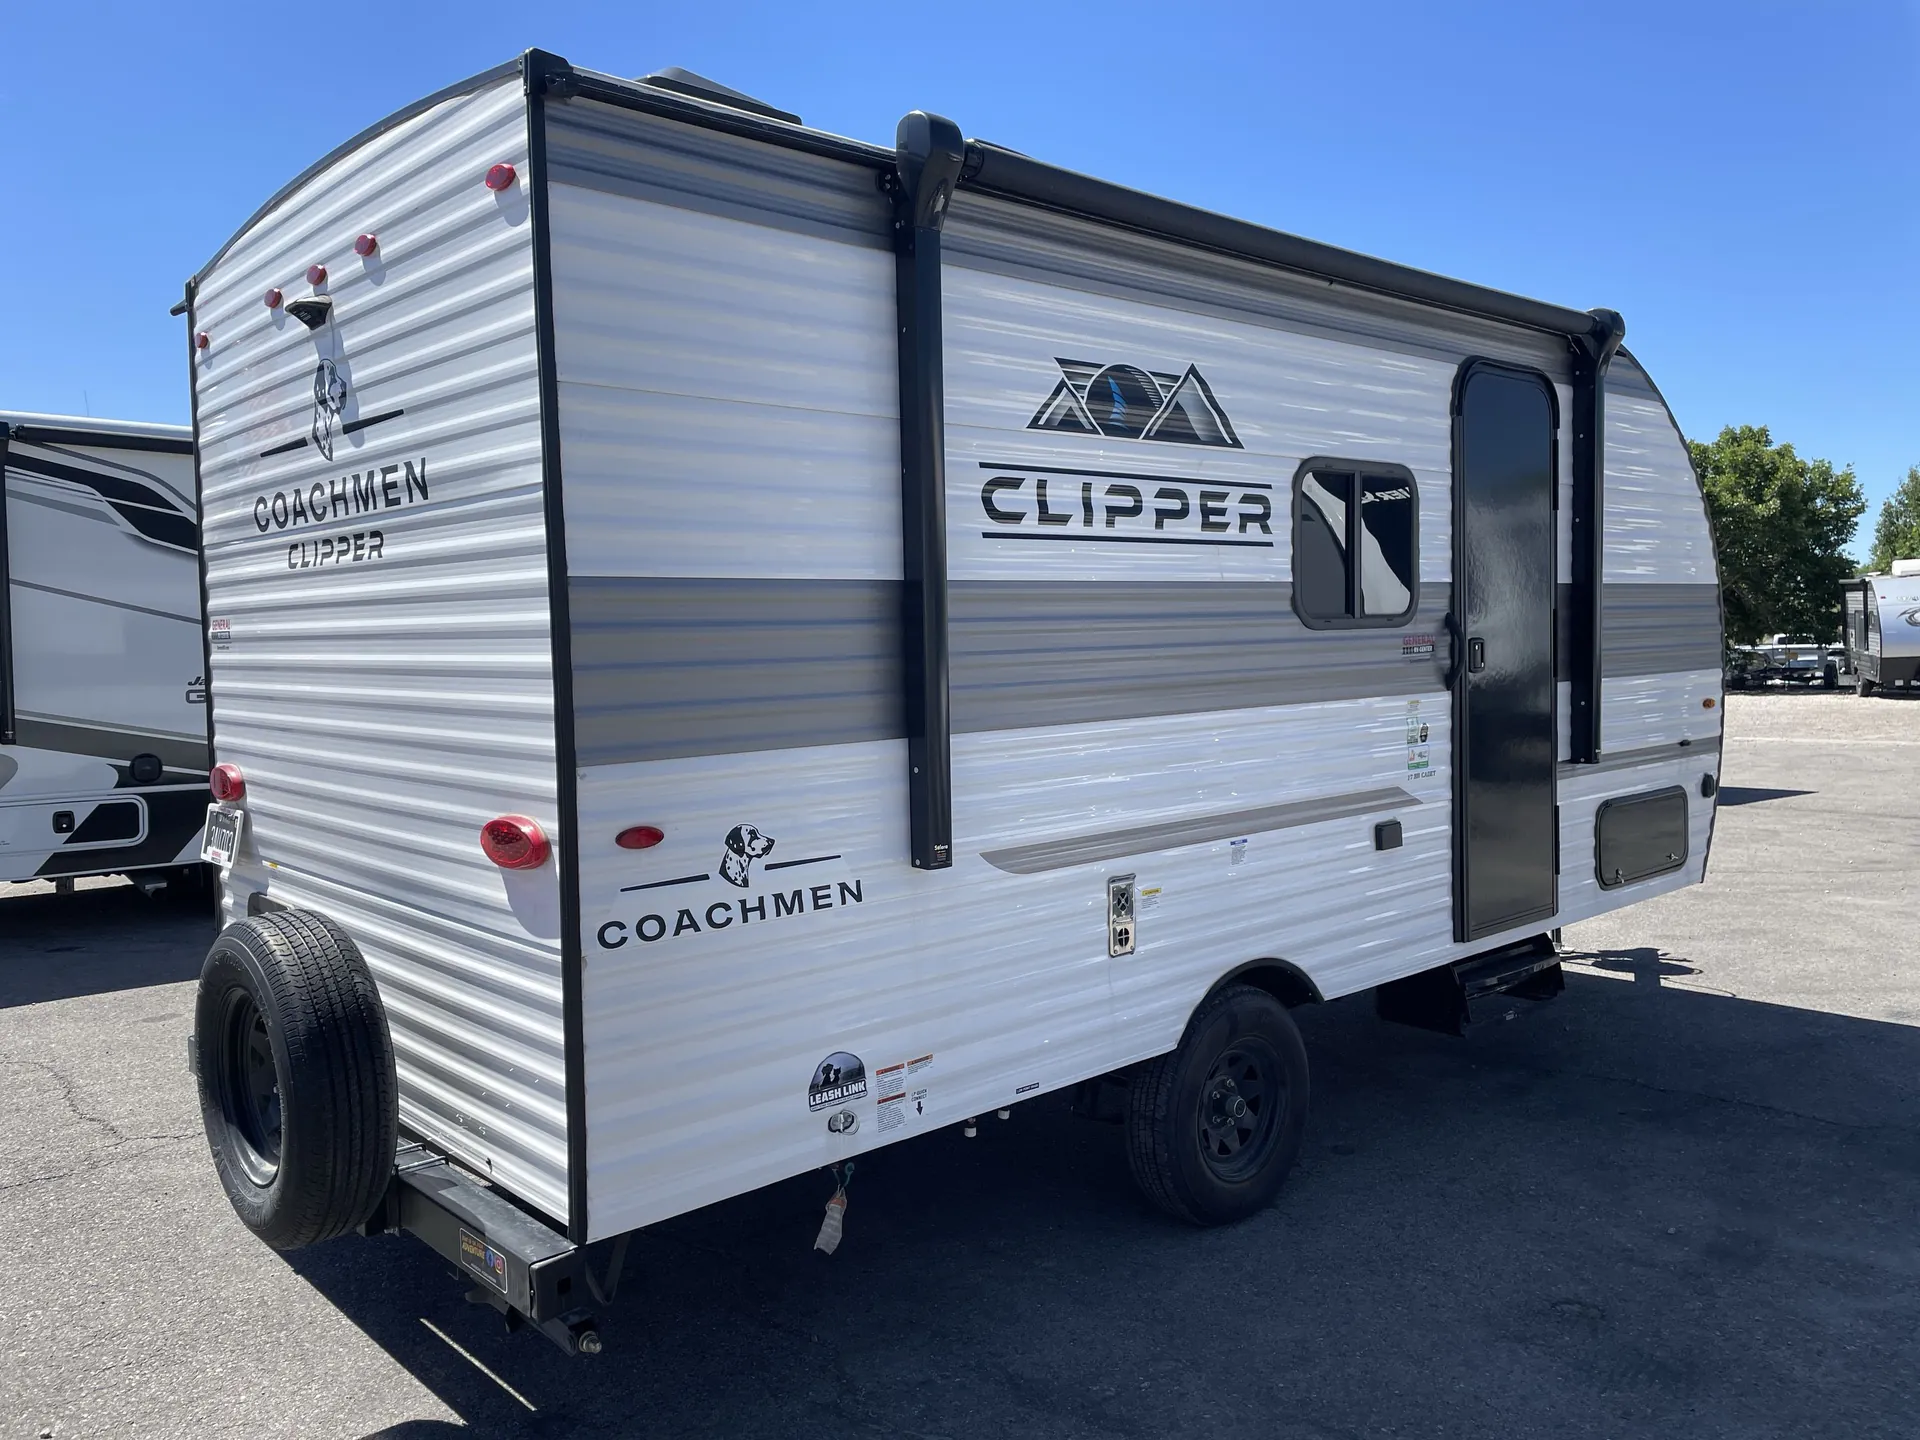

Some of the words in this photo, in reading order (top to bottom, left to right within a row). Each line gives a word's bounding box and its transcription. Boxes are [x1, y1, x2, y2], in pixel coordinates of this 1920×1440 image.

[254, 457, 429, 533] COACHMEN
[981, 476, 1273, 535] CLIPPER
[288, 530, 384, 570] CLIPPER
[1402, 635, 1435, 646] GENERAL
[597, 879, 864, 949] COACHMEN
[810, 1088, 842, 1106] LEASH
[843, 1081, 867, 1097] LINK
